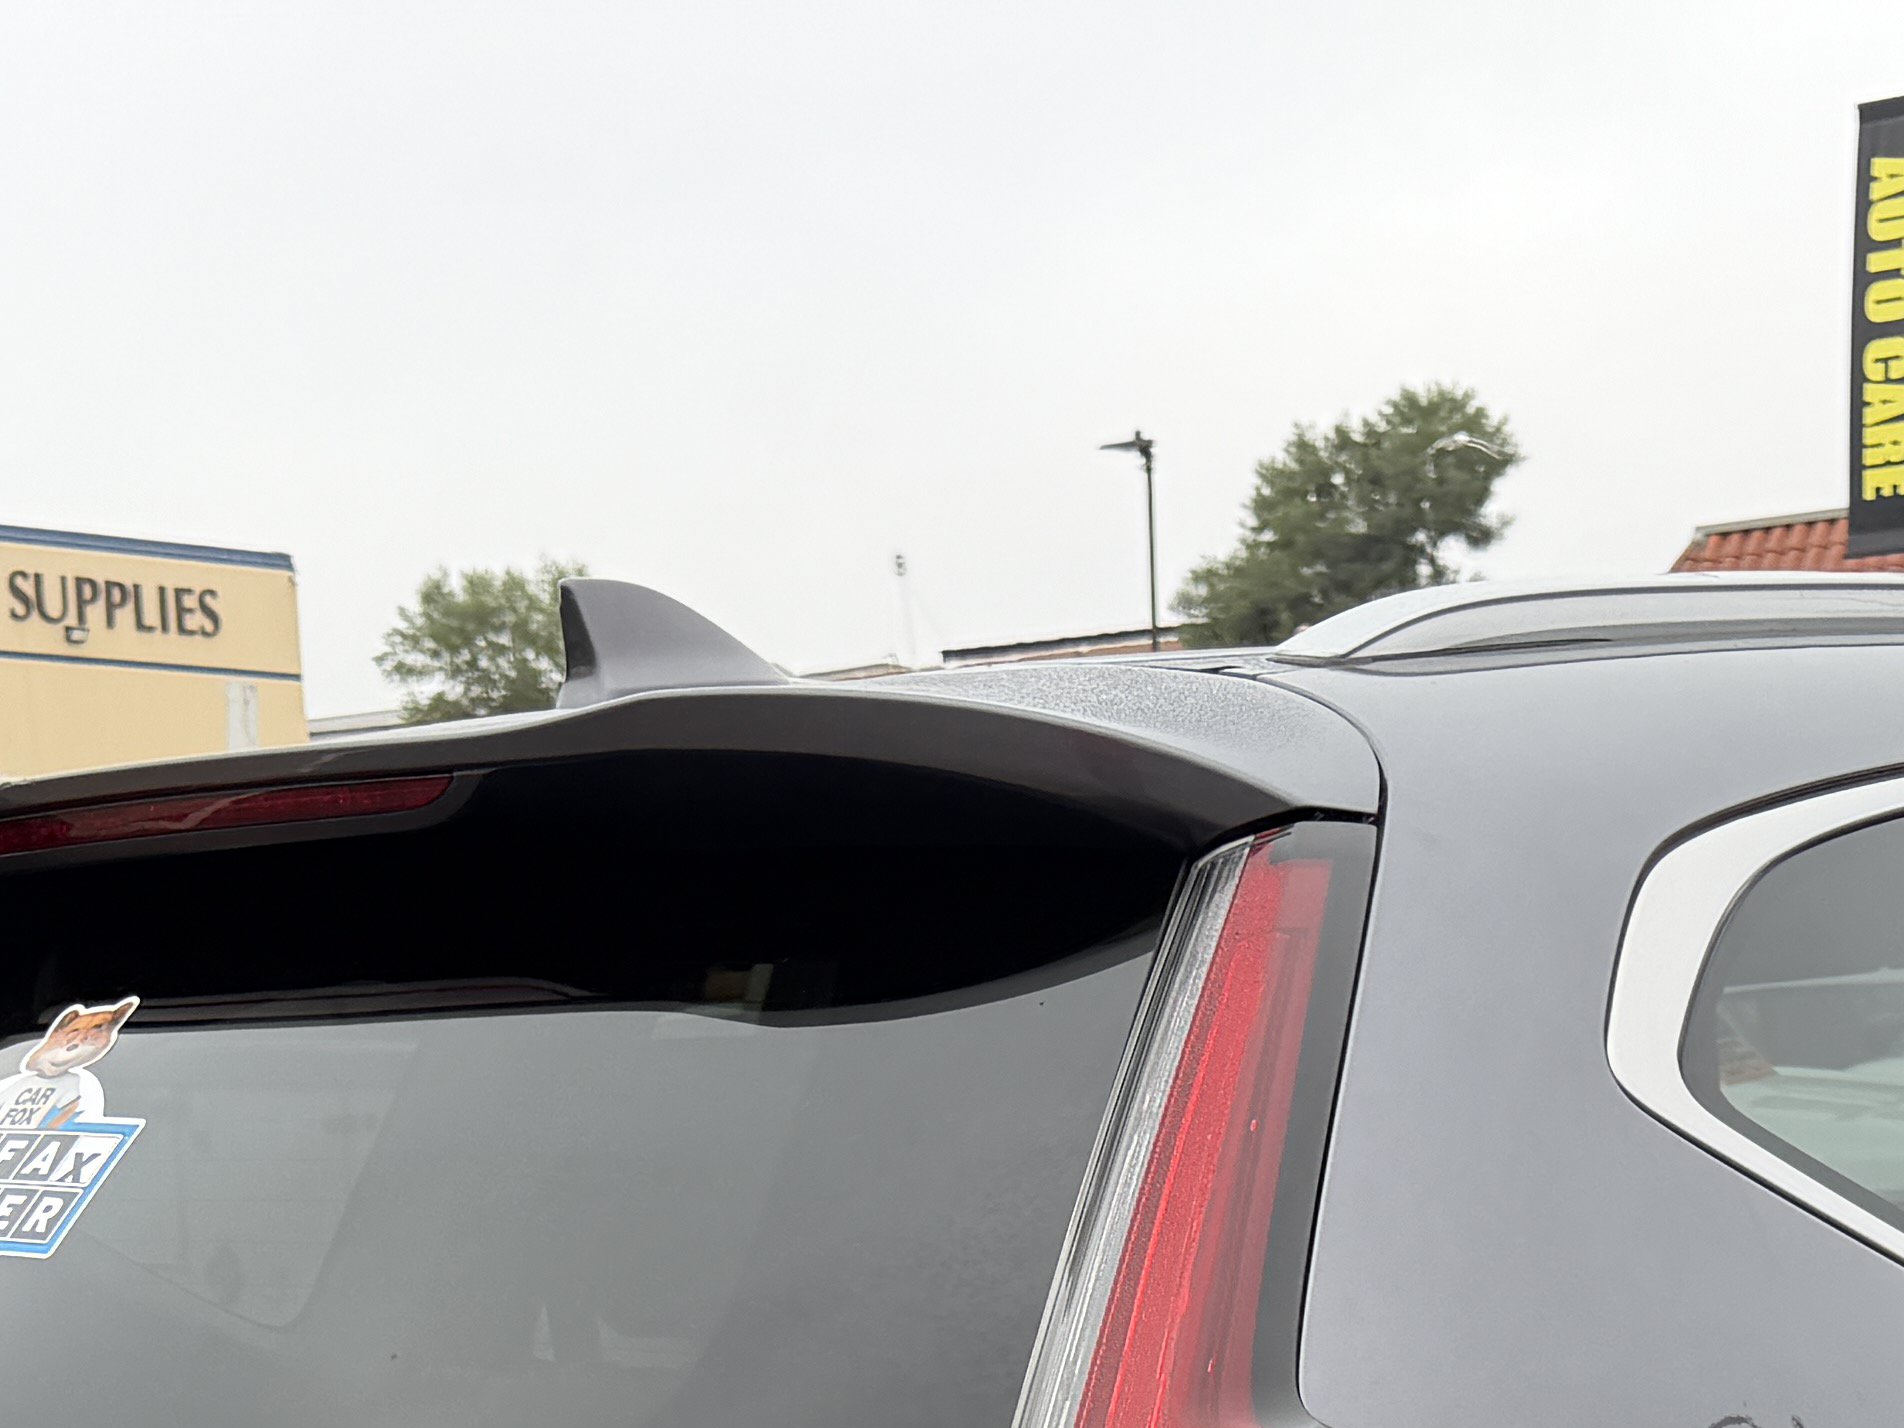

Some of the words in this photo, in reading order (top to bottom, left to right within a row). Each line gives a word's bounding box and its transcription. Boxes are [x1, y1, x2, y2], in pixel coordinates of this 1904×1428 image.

[8, 569, 223, 639] SUPPLIES
[14, 1087, 57, 1106] CAR
[0, 1107, 41, 1126] FOX
